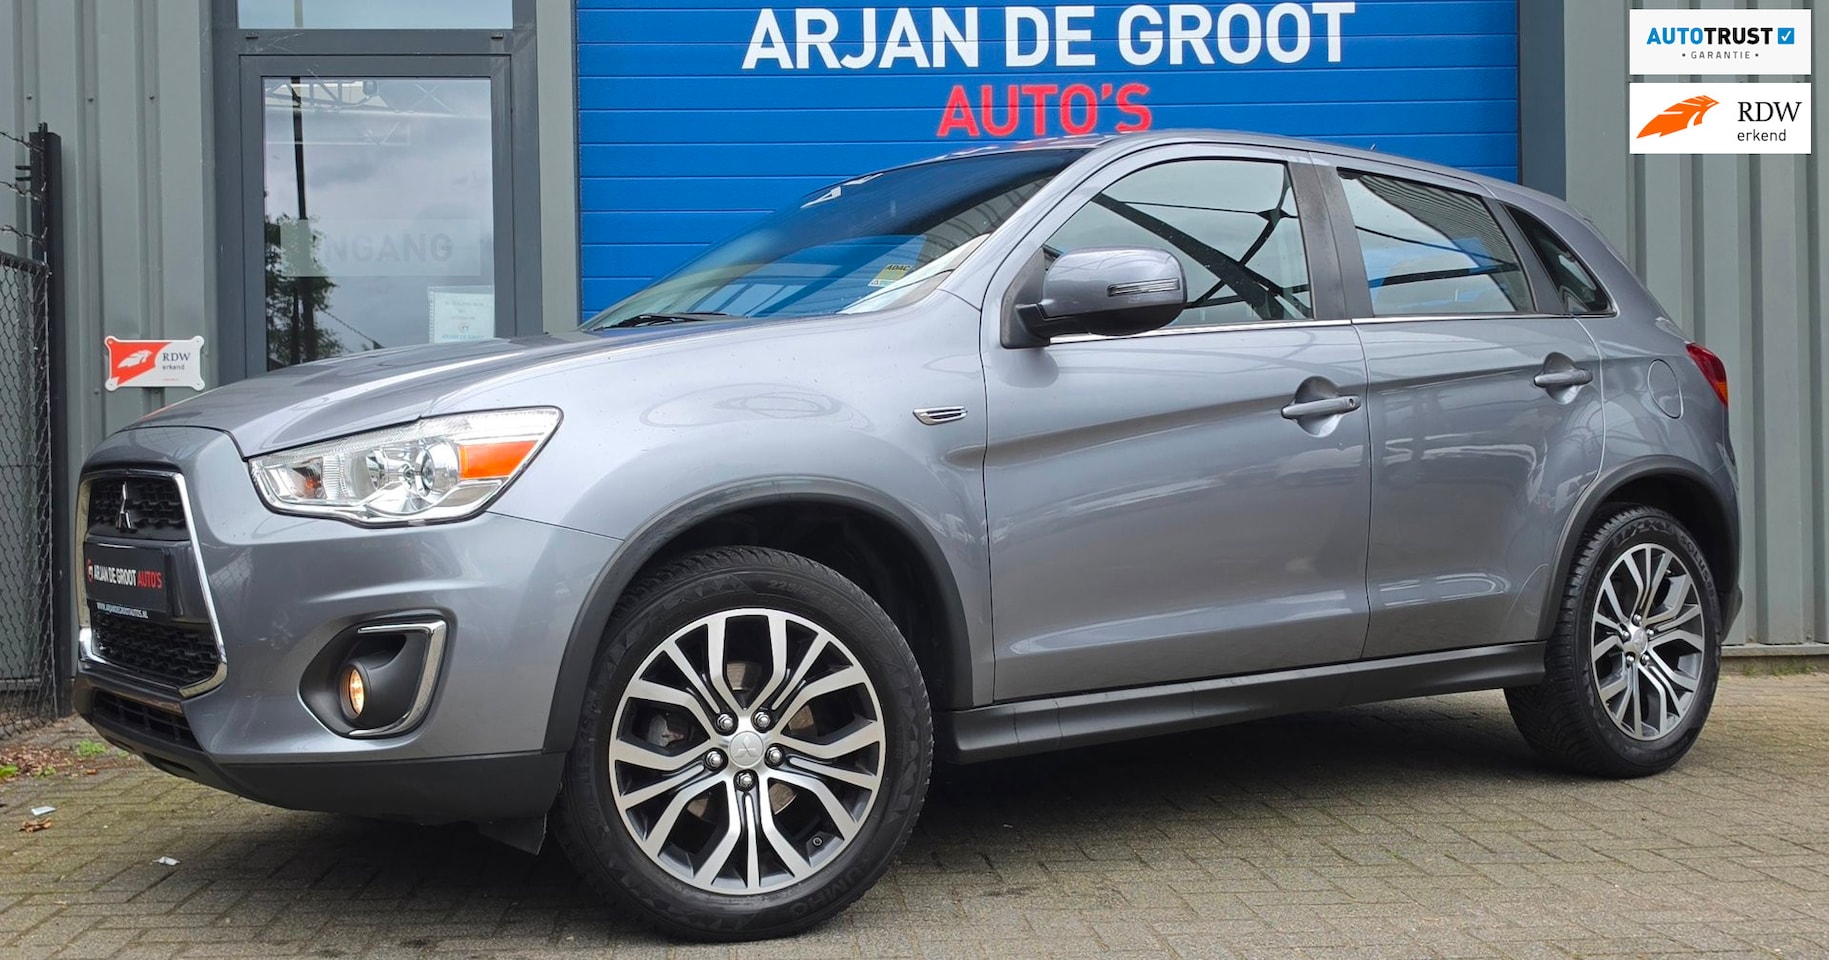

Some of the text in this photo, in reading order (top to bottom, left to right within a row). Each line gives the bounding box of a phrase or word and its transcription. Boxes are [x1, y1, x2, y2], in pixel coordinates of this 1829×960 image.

[742, 2, 1356, 69] ARJAN DE GROOT
[936, 82, 1153, 137] AUTO'S
[162, 352, 191, 362] RDW
[109, 566, 117, 584] DE
[116, 567, 137, 586] GROOT
